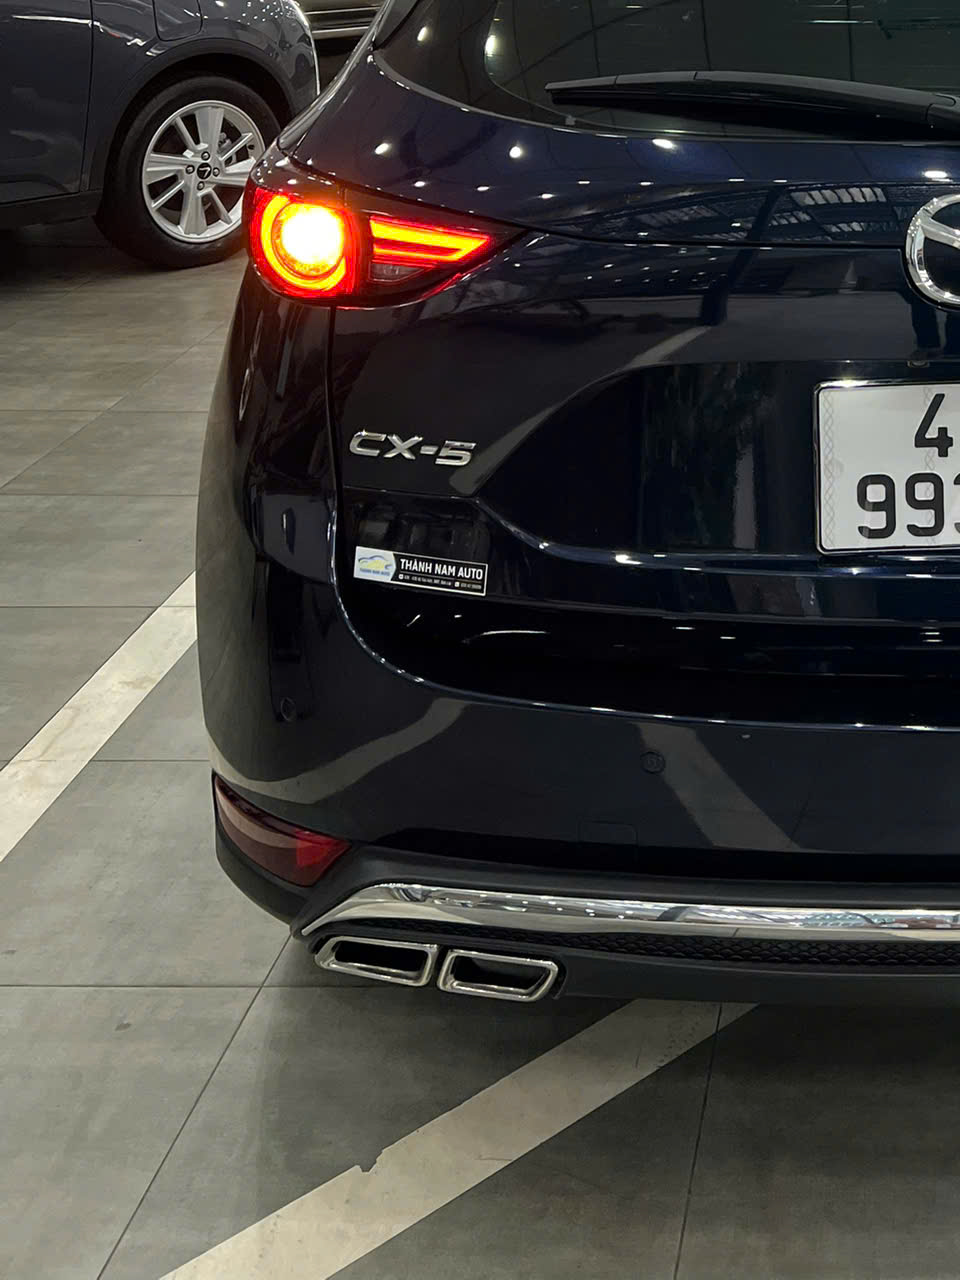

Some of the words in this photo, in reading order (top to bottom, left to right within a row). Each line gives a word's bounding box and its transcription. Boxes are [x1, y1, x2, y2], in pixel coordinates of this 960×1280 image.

[349, 430, 477, 466] CX-5
[400, 558, 432, 574] THÀNH
[434, 563, 456, 577] NAM
[457, 566, 484, 580] AUTO
